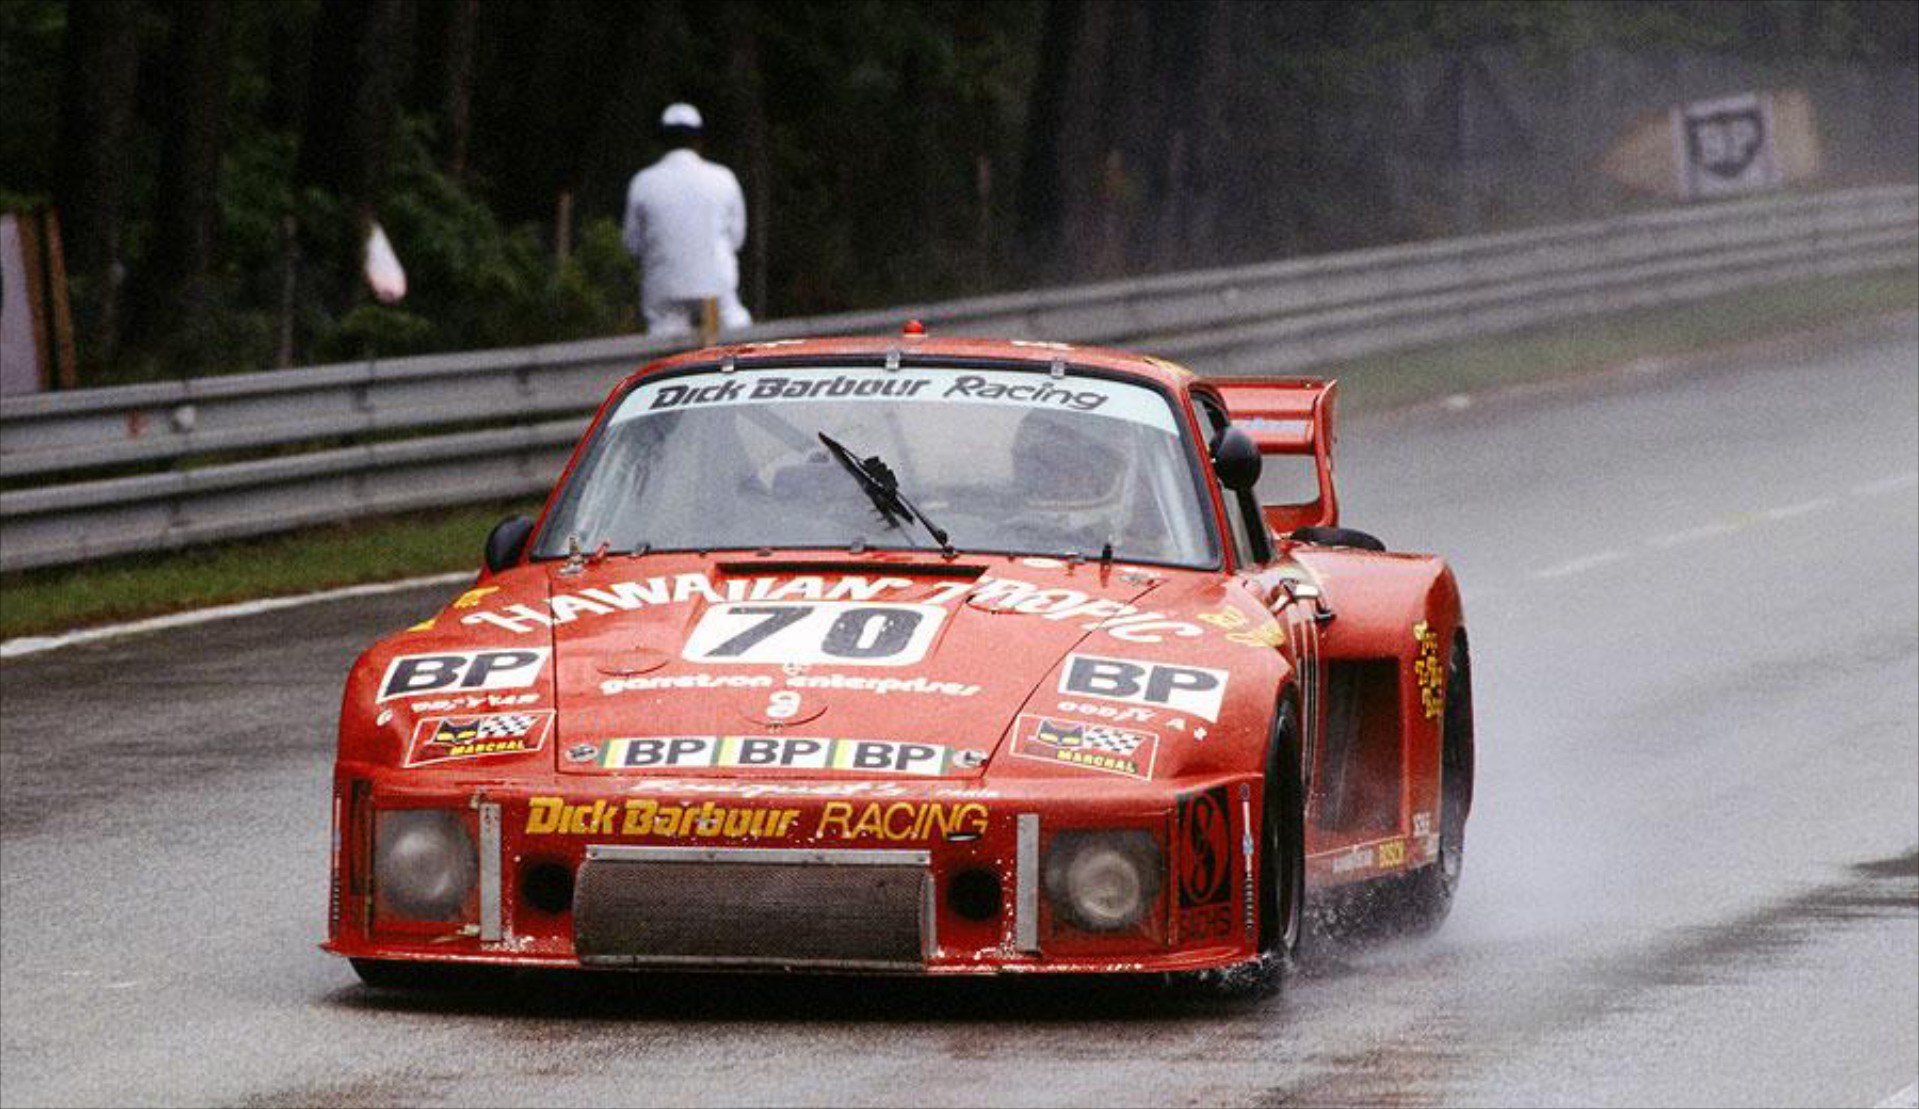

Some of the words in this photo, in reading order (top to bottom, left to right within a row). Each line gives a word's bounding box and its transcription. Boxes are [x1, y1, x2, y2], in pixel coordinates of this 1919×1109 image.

[648, 379, 746, 409] Dick
[749, 376, 933, 400] Barbour
[942, 376, 1110, 411] Racing
[460, 573, 914, 633] HAWAIIAN
[919, 576, 1203, 643] TROPIC
[703, 606, 925, 659] 70
[385, 651, 541, 698] BP
[1065, 656, 1222, 704] BP
[623, 739, 707, 767] BP
[738, 738, 821, 767] BP
[852, 741, 936, 770] BP
[524, 797, 621, 836] Dick
[621, 799, 800, 838] Barbour
[817, 801, 990, 842] RACING
